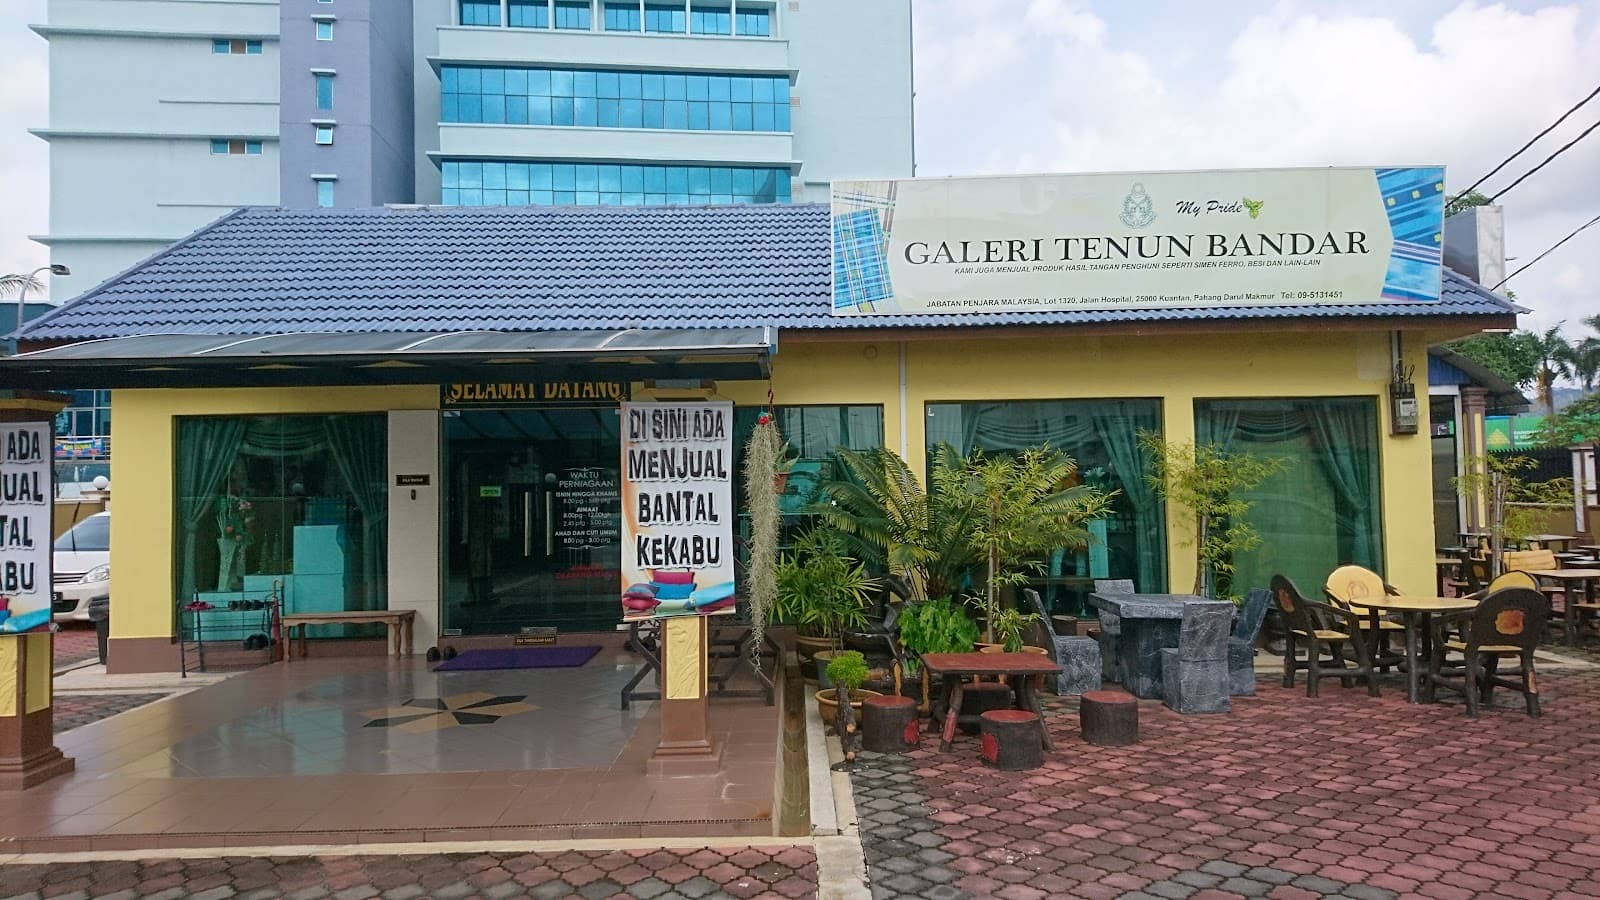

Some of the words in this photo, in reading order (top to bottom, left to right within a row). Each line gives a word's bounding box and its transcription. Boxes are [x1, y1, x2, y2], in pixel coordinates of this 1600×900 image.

[1175, 200, 1201, 217] My
[1206, 198, 1243, 214] Pride
[904, 238, 1044, 265] GALERI
[1054, 234, 1195, 261] TENUN
[1207, 230, 1370, 257] BANDAR
[954, 267, 974, 275] KAMI
[927, 300, 961, 308] JABATAN
[963, 299, 999, 307] PENJARA
[1101, 295, 1134, 303] Hospital,
[1160, 294, 1192, 302] Kuantan,
[1194, 294, 1222, 302] Pahang
[1281, 291, 1295, 299] Tel:
[1297, 291, 1343, 299] 09-5131451
[629, 408, 647, 439] DI
[652, 407, 688, 439] SINI
[693, 408, 725, 438] ADA
[7, 429, 41, 460] ADA
[570, 471, 599, 479] WAKTU
[628, 447, 727, 480] MENJUAL
[0, 471, 43, 502] UAL
[559, 480, 614, 488] PERNIAGAAN
[638, 491, 718, 523] BANTAL
[637, 534, 720, 567] KEKABU
